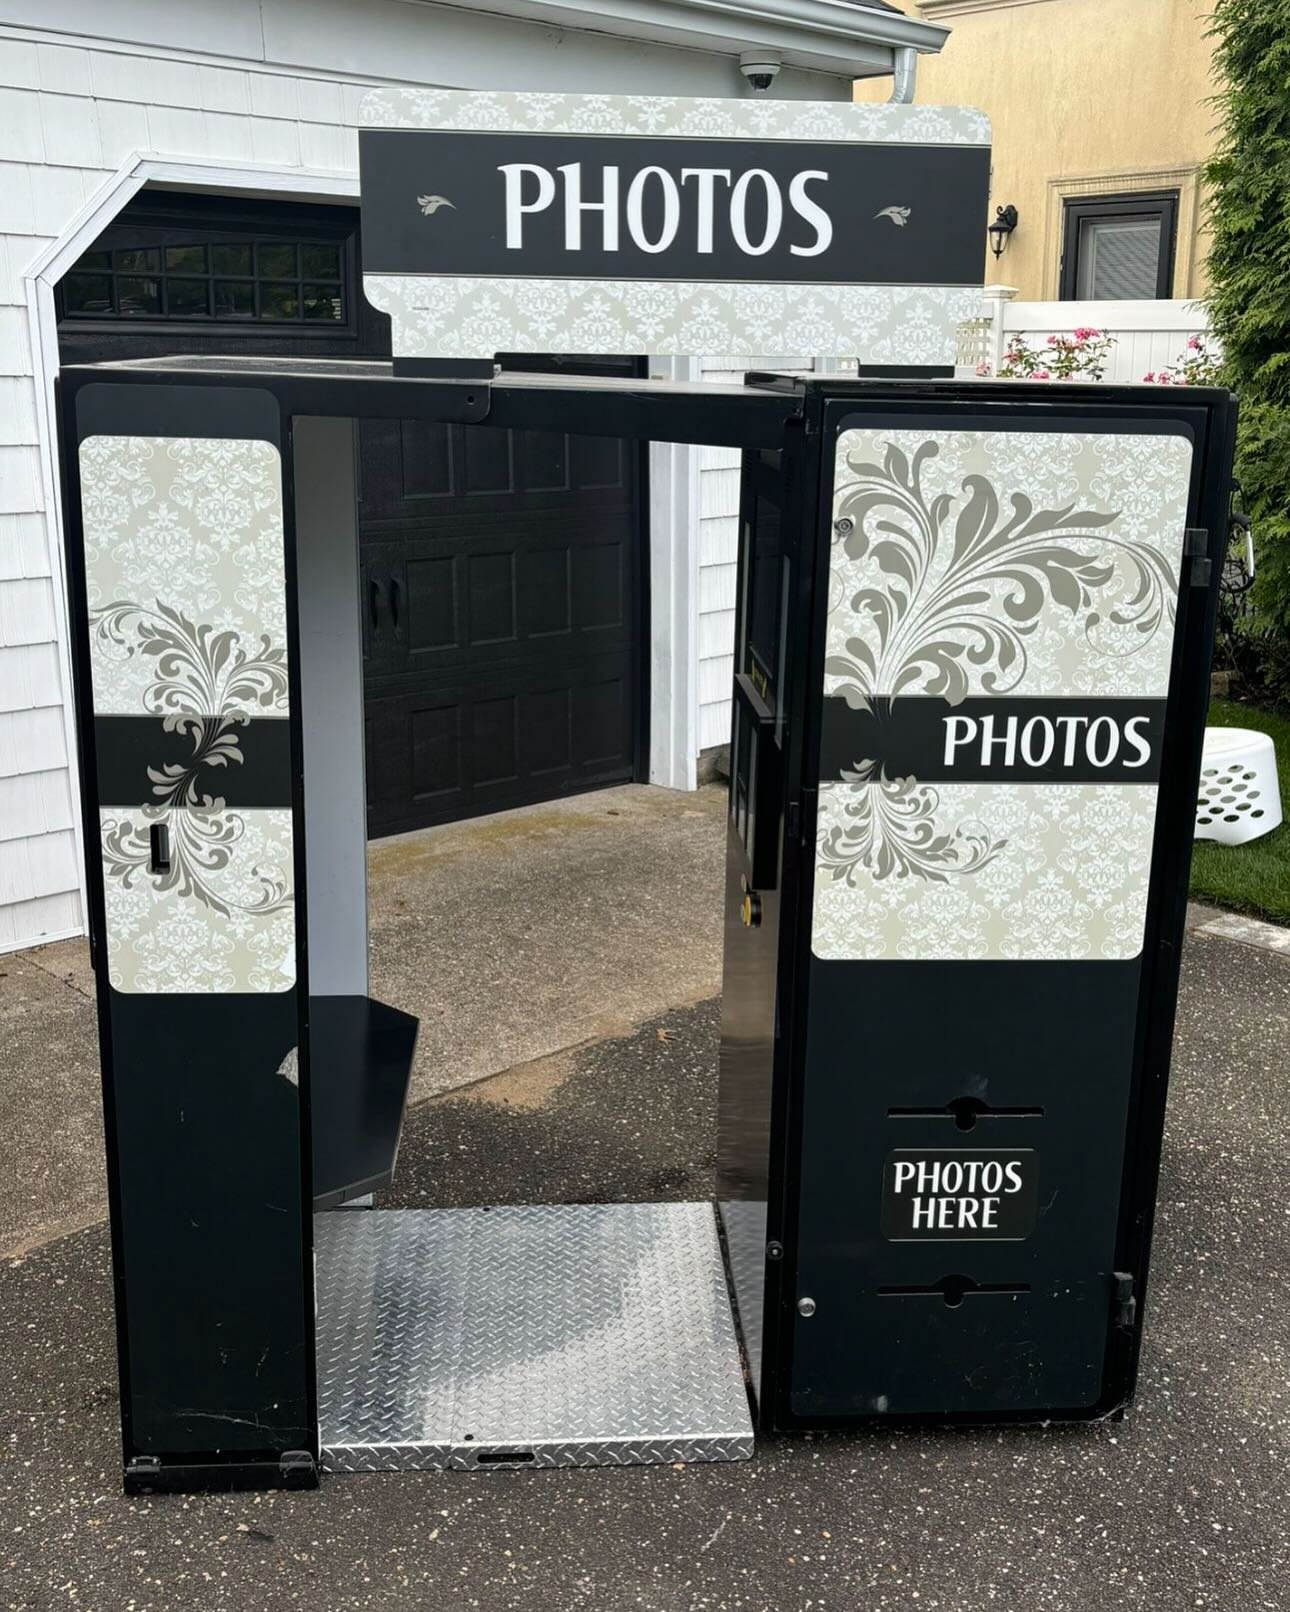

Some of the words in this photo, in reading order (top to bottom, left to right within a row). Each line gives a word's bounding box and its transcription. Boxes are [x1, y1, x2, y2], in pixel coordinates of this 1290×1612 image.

[496, 162, 833, 257] PHOTOS
[942, 714, 1151, 768] PHOTOS
[893, 1160, 1022, 1194] PHOTOS
[911, 1196, 1001, 1229] HERE
